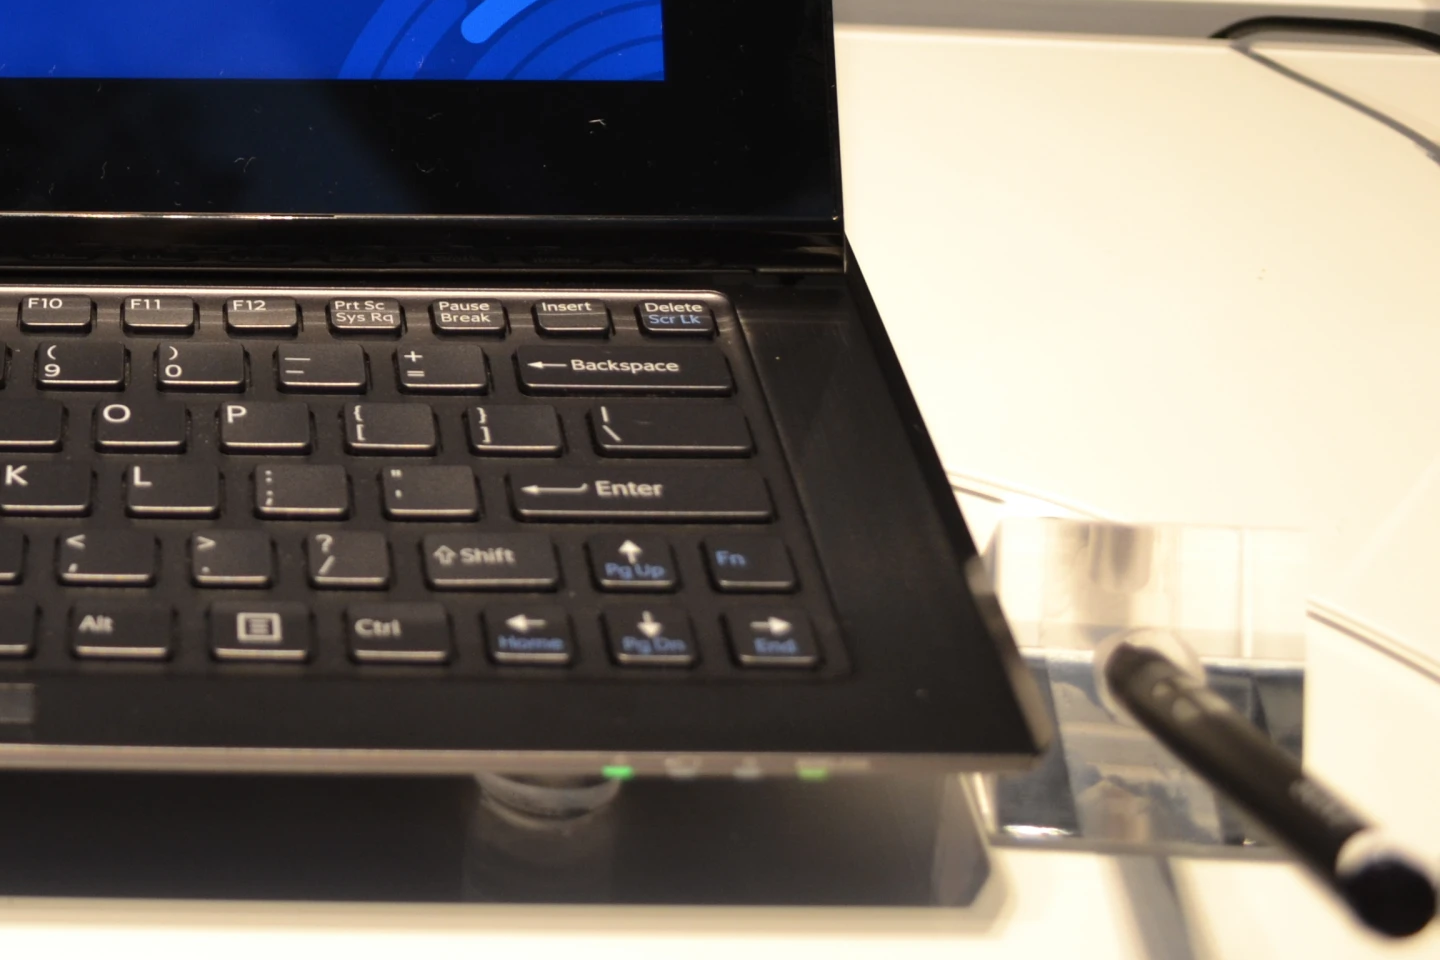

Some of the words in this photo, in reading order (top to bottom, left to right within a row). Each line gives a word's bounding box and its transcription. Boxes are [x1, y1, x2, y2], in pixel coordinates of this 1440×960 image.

[27, 297, 63, 309] F10
[130, 299, 161, 310] F11
[232, 299, 267, 311] F12
[334, 300, 361, 311] Prt
[364, 300, 386, 311] Sc
[438, 301, 490, 312] Pause
[541, 301, 593, 312] Insert
[644, 302, 703, 313] Delete
[335, 312, 367, 324] Sys
[370, 313, 395, 325] Rq
[440, 312, 492, 323] Break
[648, 314, 680, 324] Scr
[683, 314, 701, 324] Lk
[44, 364, 61, 377] 9
[571, 359, 680, 374] Backspace
[103, 404, 131, 423] O
[227, 405, 247, 423] P
[5, 465, 28, 485] K
[133, 466, 152, 487] L
[595, 480, 663, 496] Enter
[460, 547, 515, 563] Shift
[716, 551, 747, 566] Fn
[605, 562, 632, 581] Pg
[634, 563, 666, 580] Up
[79, 616, 114, 632] Alt
[355, 619, 401, 636] Ctrl
[499, 636, 564, 650] Home
[622, 636, 651, 654] Pg
[655, 637, 686, 651] Dn
[755, 638, 797, 654] End
